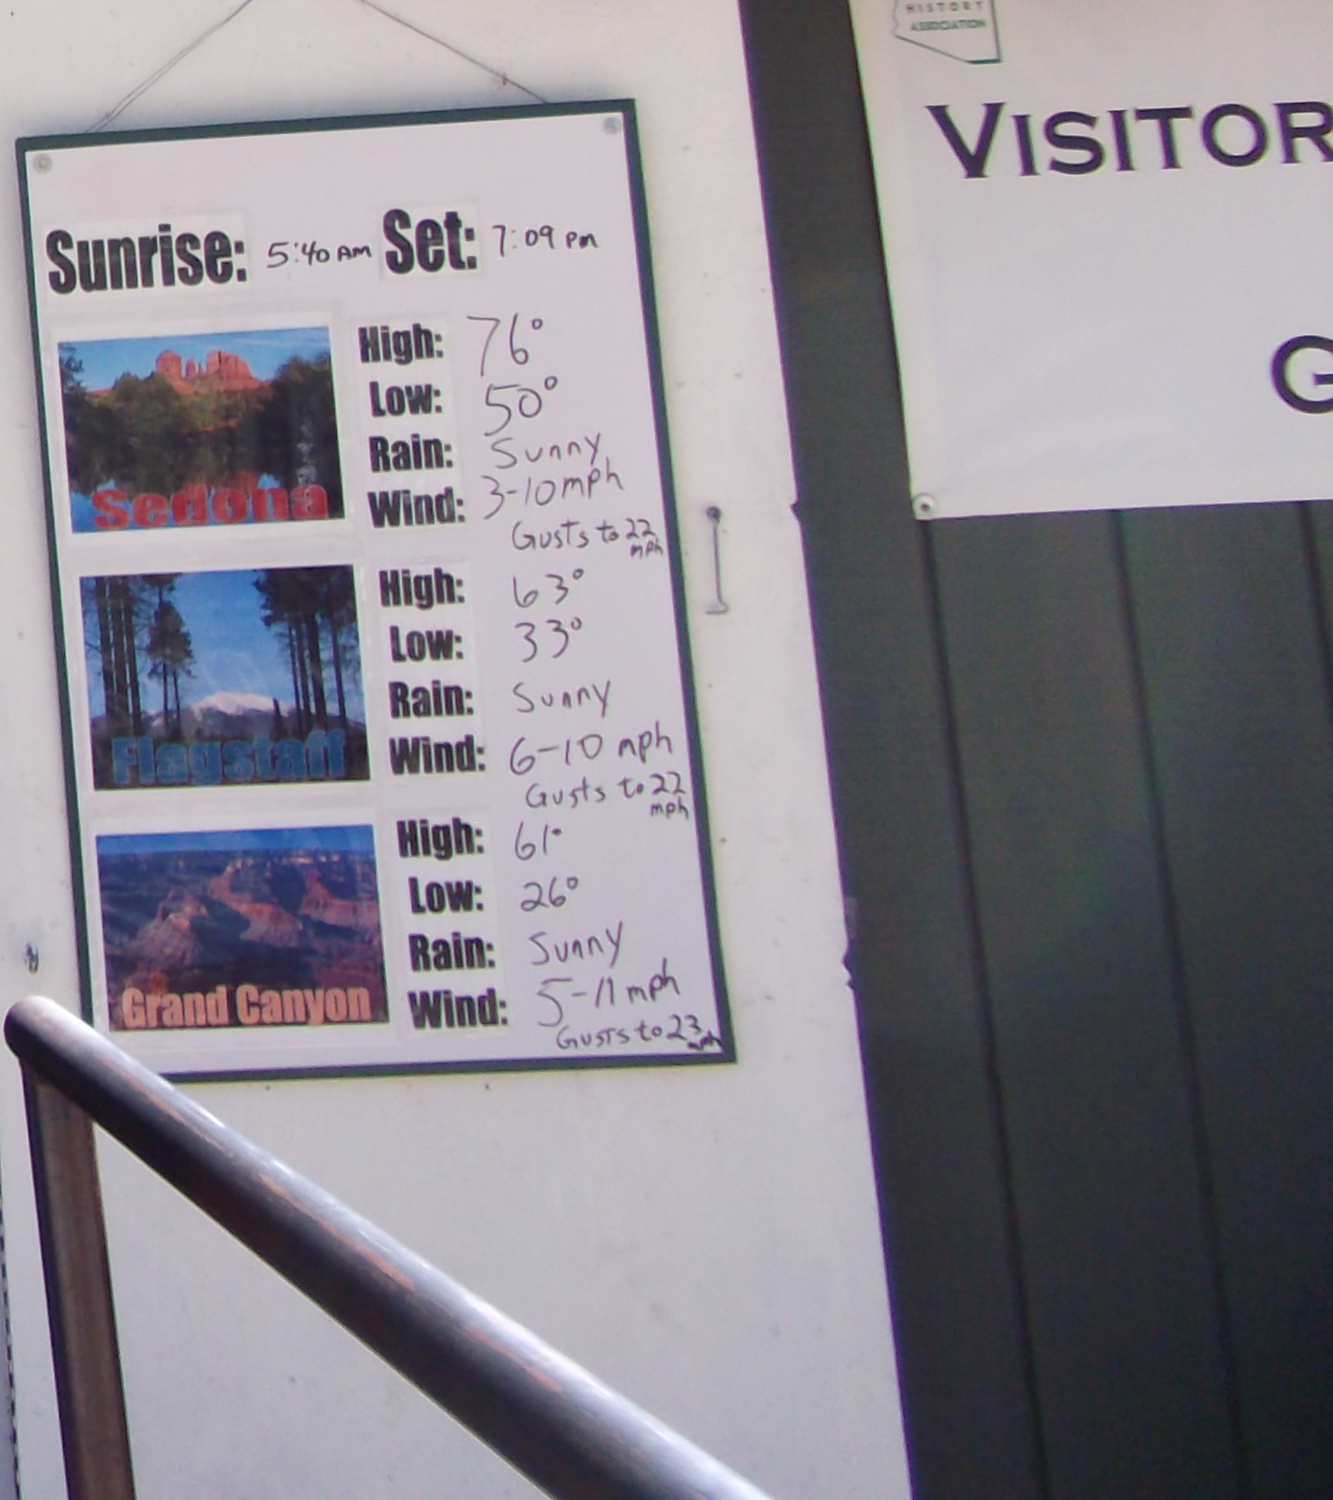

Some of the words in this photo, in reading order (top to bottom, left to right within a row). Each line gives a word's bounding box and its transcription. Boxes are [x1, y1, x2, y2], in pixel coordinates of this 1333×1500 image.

[906, 1, 982, 13] HISTORY
[45, 223, 247, 295] Sunrise:
[266, 241, 330, 269] 5:40
[383, 208, 478, 275] Set:
[492, 225, 555, 257] 7:09
[358, 323, 444, 366] High:
[369, 380, 443, 417] Low:
[368, 433, 453, 473] Rain:
[491, 432, 601, 469] Sunny
[91, 484, 329, 531] Sedona
[367, 486, 466, 529] Wind:
[595, 520, 620, 543] to
[625, 517, 655, 539] 22
[631, 537, 664, 559] mph
[379, 567, 465, 610] High:
[389, 625, 464, 663] Low:
[388, 679, 474, 719] Rain:
[513, 679, 610, 718] Sunny
[111, 729, 345, 786] Flagstaff
[389, 734, 486, 775] Wind:
[509, 733, 603, 775] 6-10
[618, 720, 673, 764] mph
[525, 777, 606, 808] Gusts
[617, 777, 644, 799] to
[649, 771, 686, 795] 22
[651, 801, 689, 819] mph
[396, 817, 484, 861] High:
[408, 876, 484, 914] Low:
[408, 931, 495, 972] Rain:
[528, 920, 623, 968] Sunny
[122, 984, 229, 1029] Grand
[236, 984, 371, 1026] Canyon
[407, 987, 508, 1030] Wind:
[627, 957, 680, 1004] mph
[637, 1020, 662, 1041] to
[666, 1014, 701, 1041] 23
